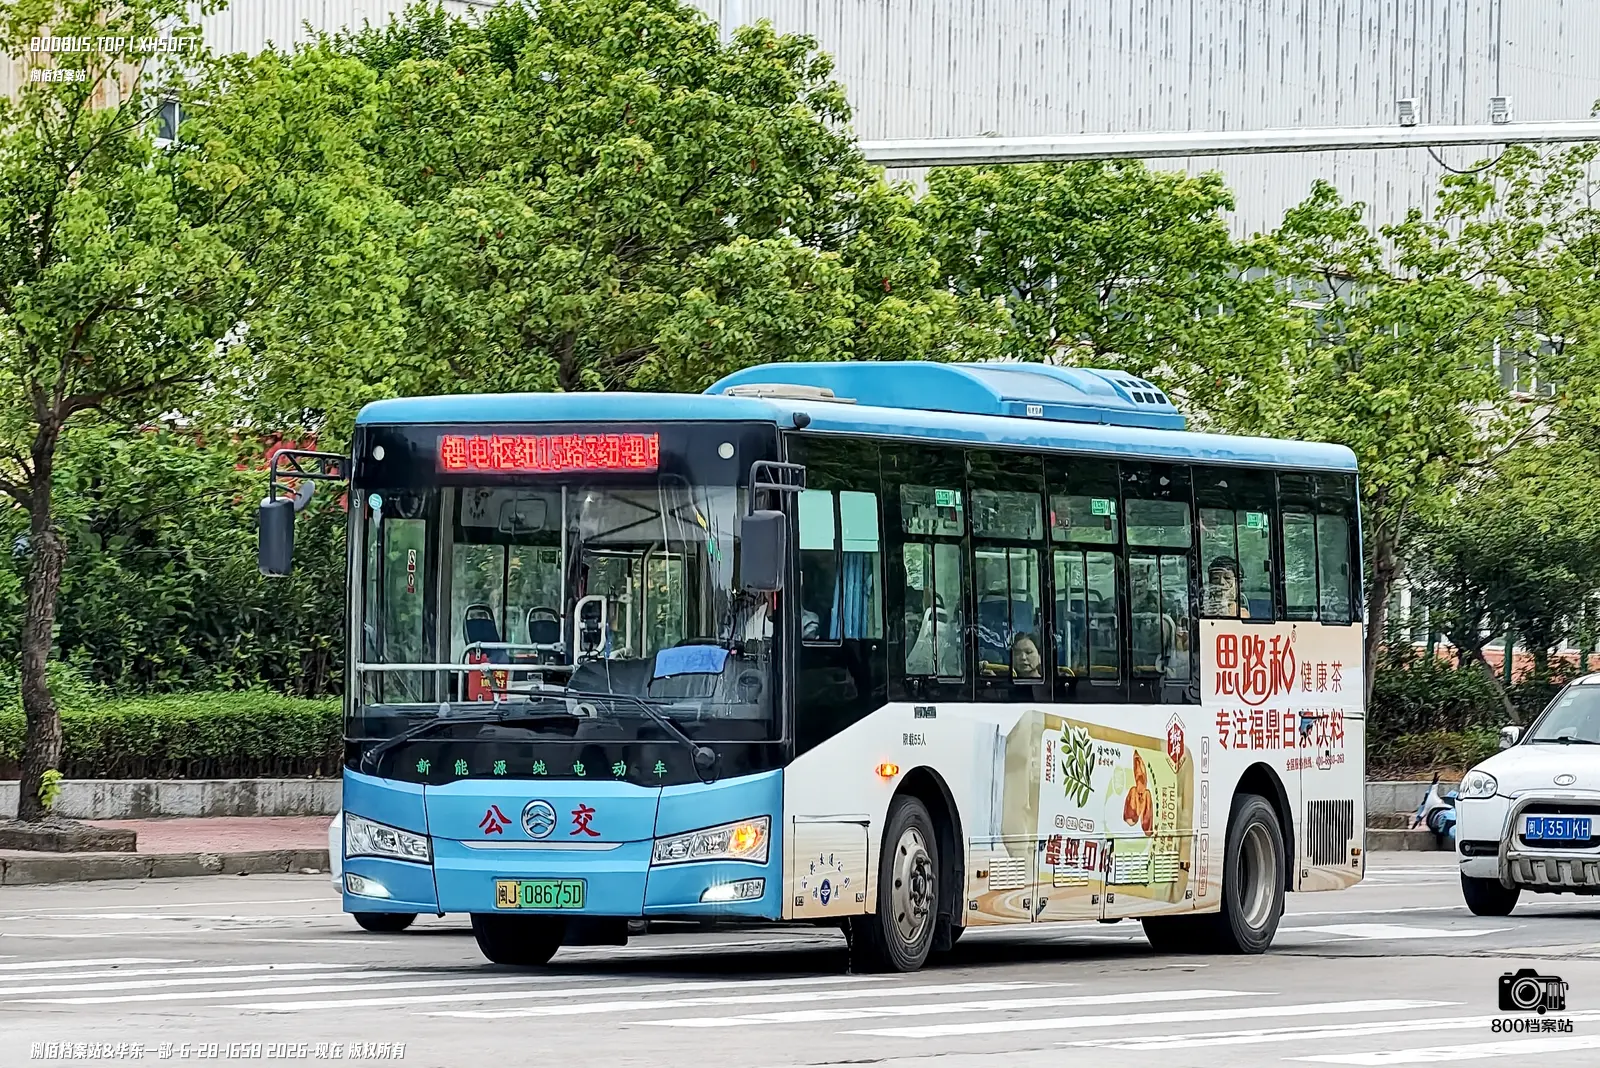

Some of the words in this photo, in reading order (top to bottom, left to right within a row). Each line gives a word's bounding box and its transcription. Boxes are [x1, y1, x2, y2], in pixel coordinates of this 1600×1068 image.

[1300, 660, 1343, 693] 健康茶
[902, 732, 927, 746] 限载55人
[416, 758, 668, 778] 新能源纯电动车
[479, 804, 512, 834] 公
[570, 803, 601, 837] 交
